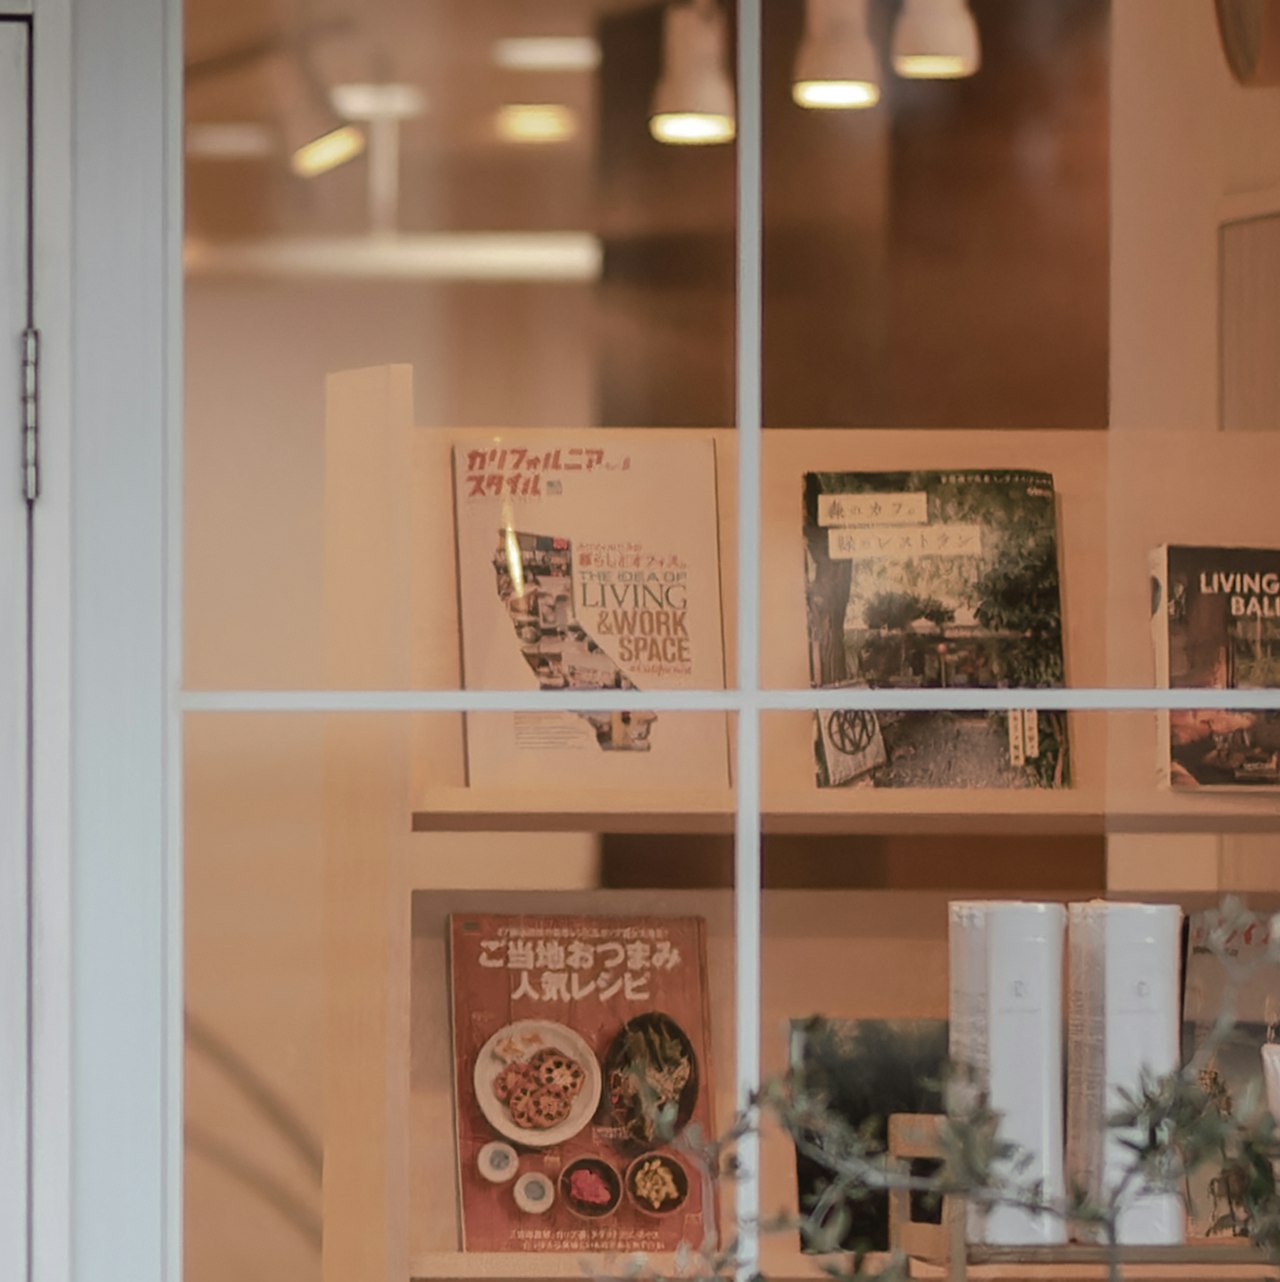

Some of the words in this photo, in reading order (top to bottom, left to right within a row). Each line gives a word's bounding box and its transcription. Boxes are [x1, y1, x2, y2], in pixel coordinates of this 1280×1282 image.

[466, 474, 542, 498] スタイル
[580, 583, 688, 609] LIVING
[619, 636, 692, 663] SPACE
[478, 940, 682, 972] ご当地おつまみ
[510, 971, 652, 1003] 人気レシピ
